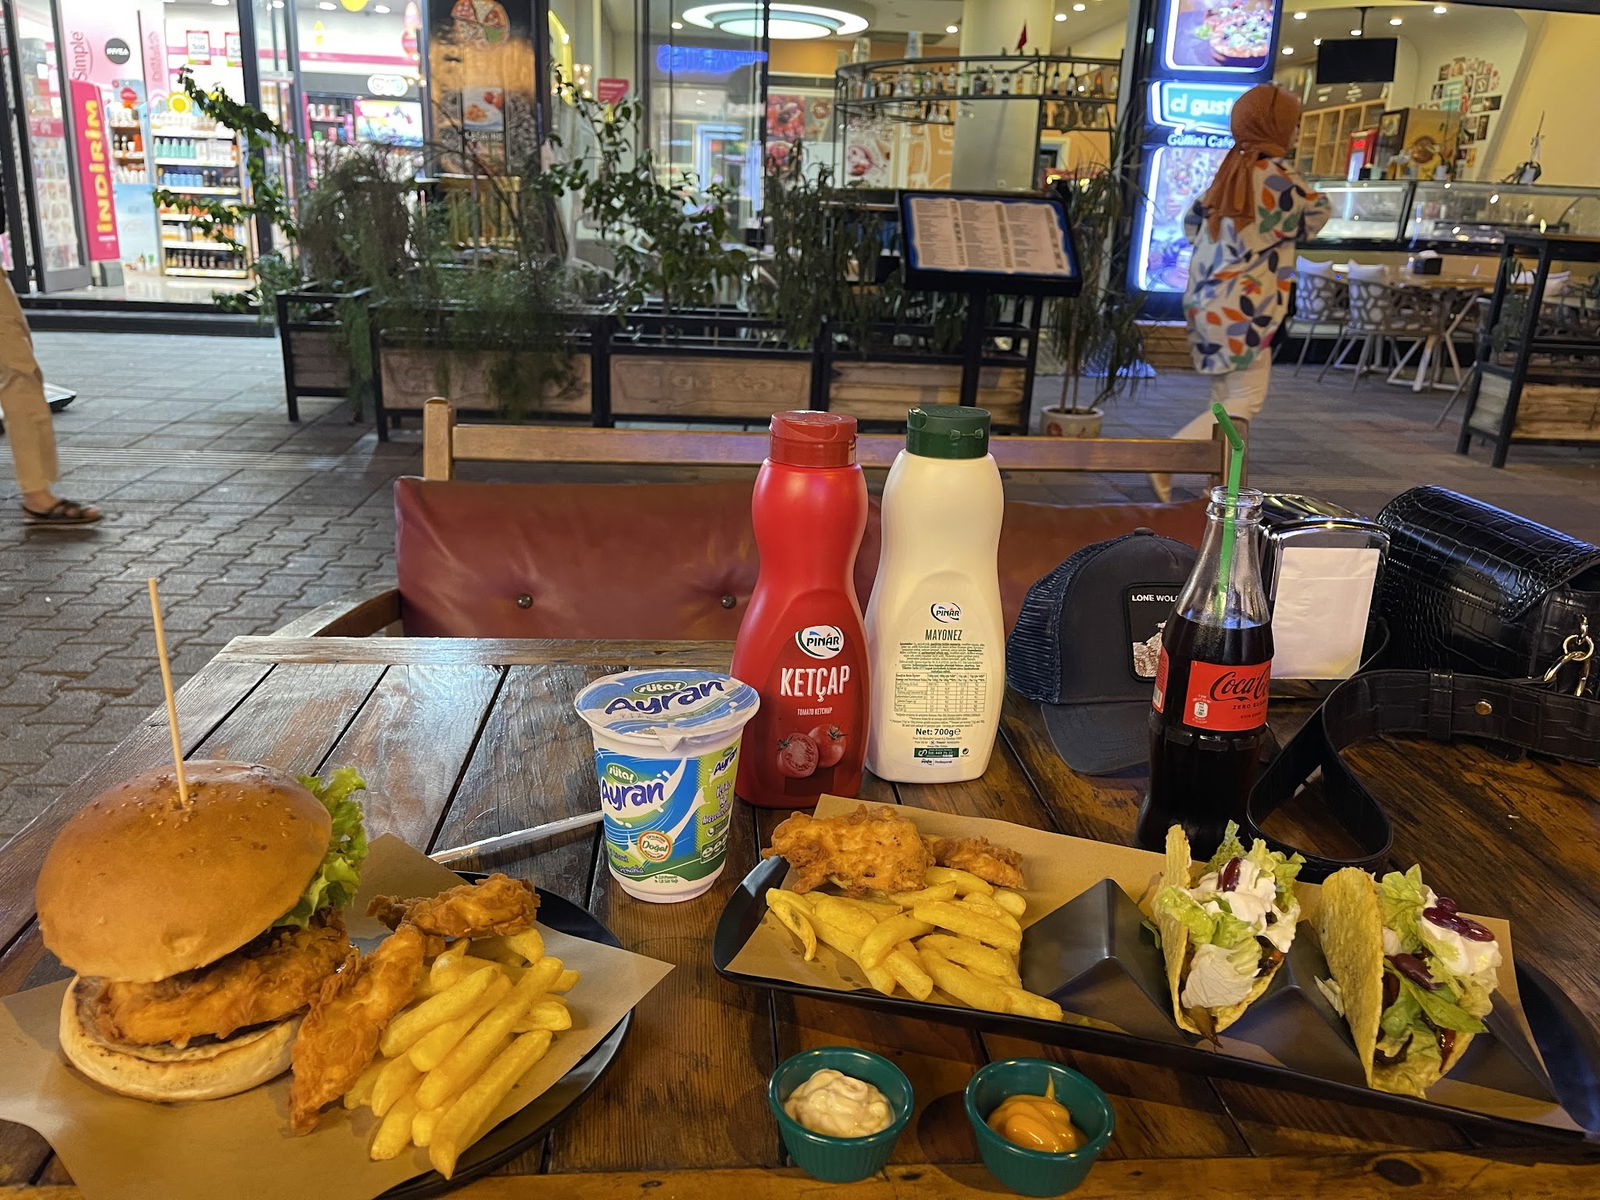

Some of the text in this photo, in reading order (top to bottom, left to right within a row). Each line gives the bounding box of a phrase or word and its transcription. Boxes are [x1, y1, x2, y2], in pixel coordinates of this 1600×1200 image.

[70, 30, 88, 80] Simple
[106, 47, 129, 56] NIVEA
[1190, 97, 1234, 117] gust
[1131, 594, 1155, 602] LONE
[925, 629, 963, 641] MAYONEZ
[780, 665, 851, 702] KETÇAP
[605, 680, 724, 715] Ayran
[915, 728, 933, 736] Net:
[601, 780, 665, 811] Ayran
[643, 840, 669, 853] Doğal
